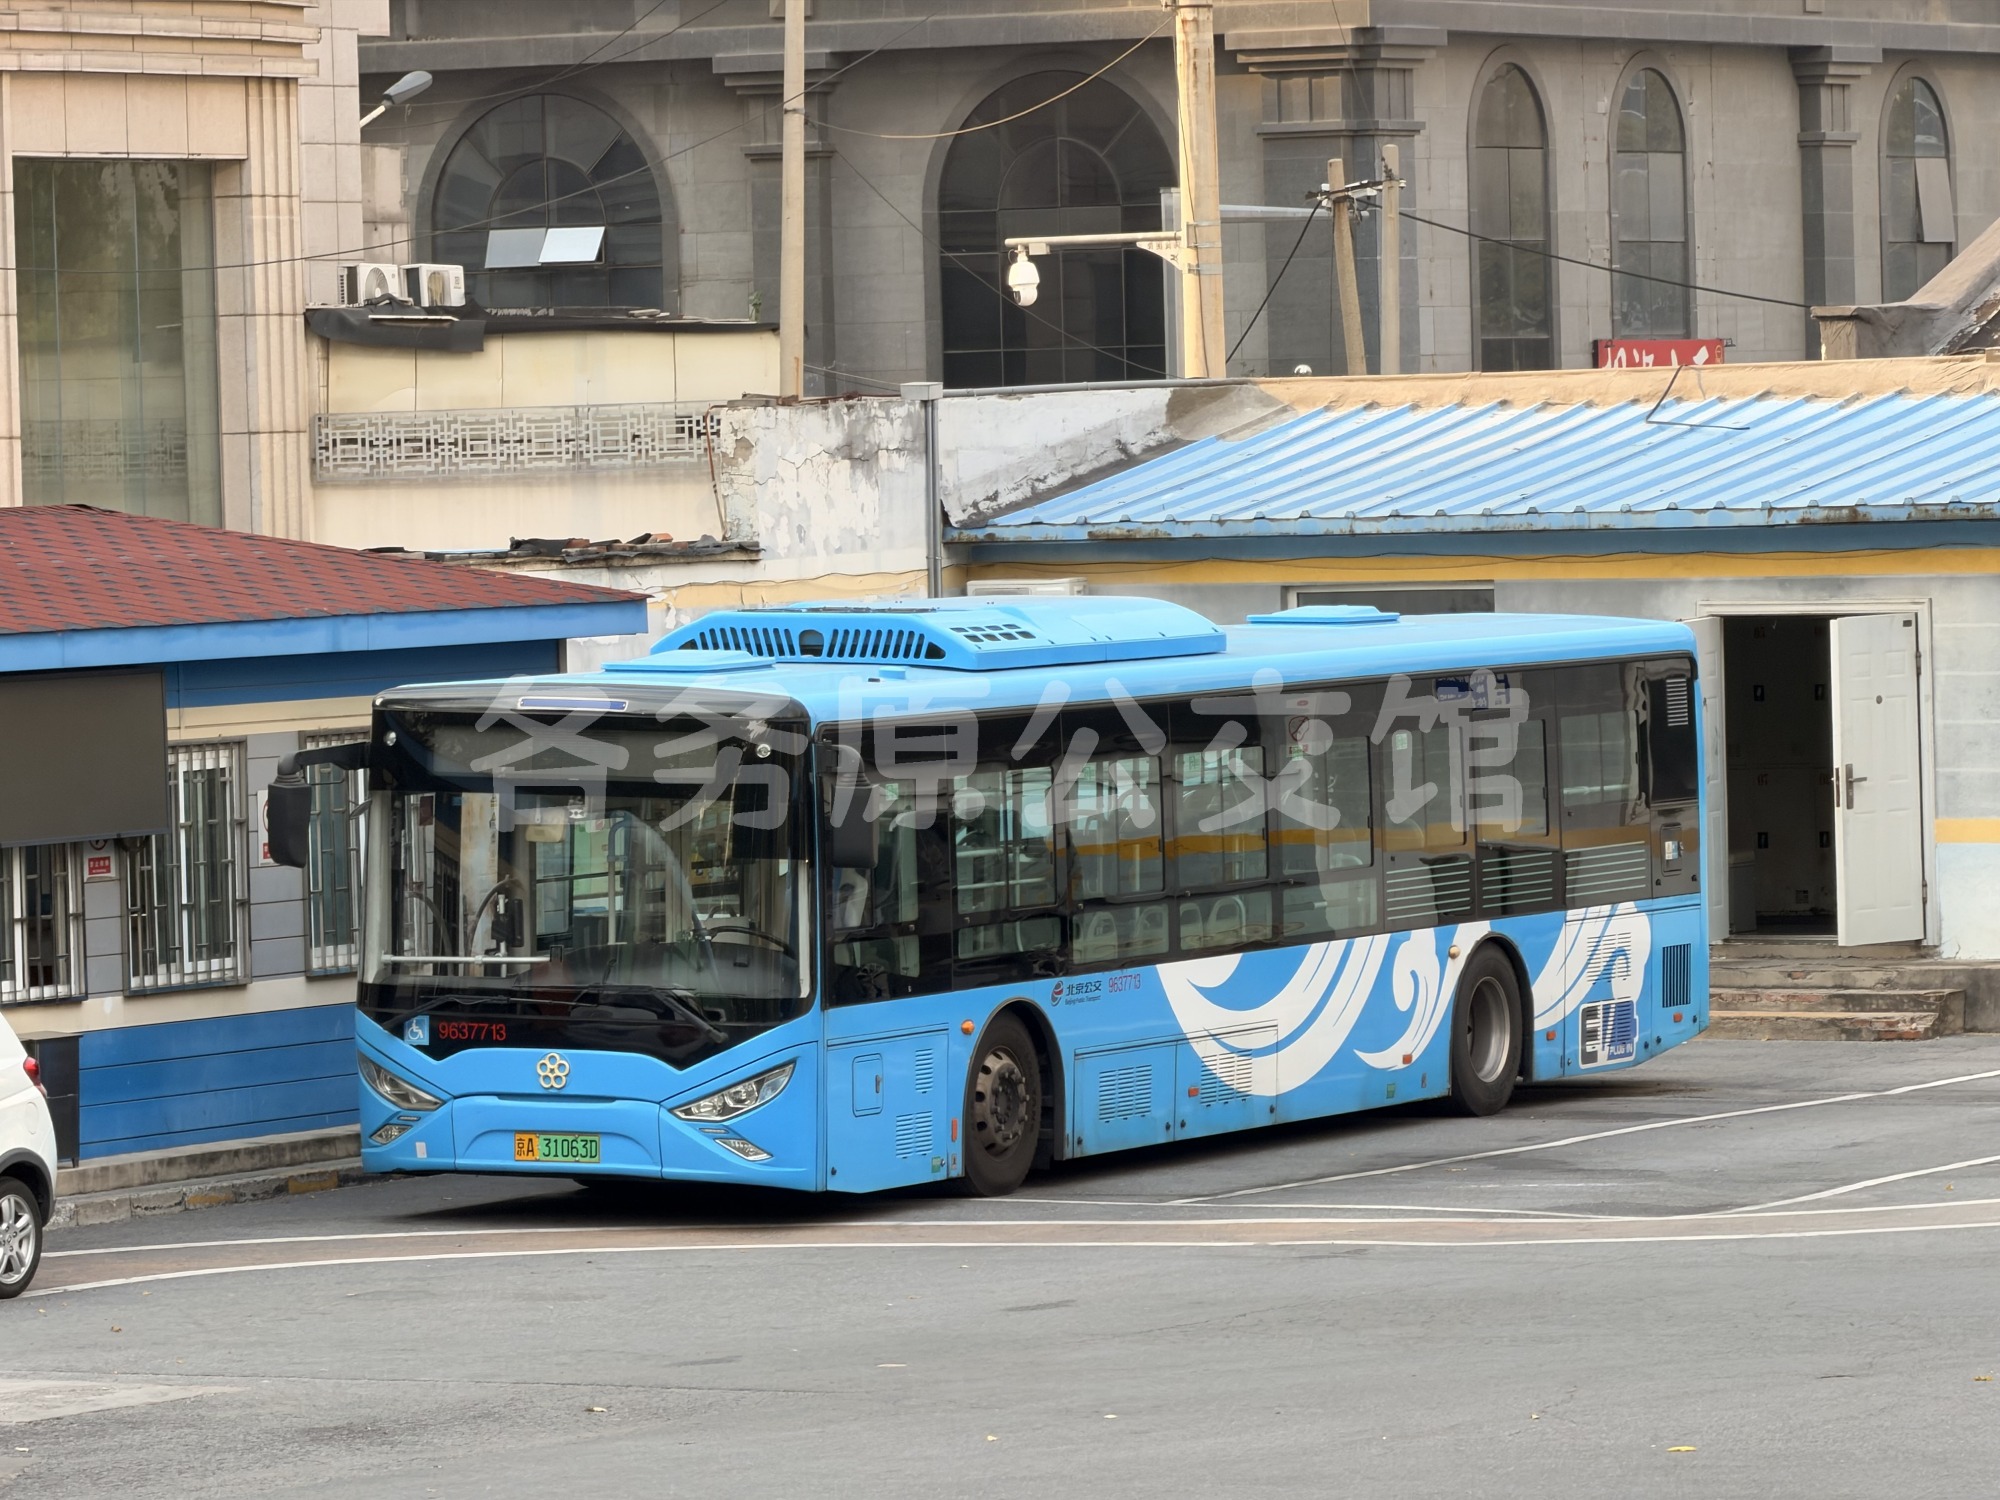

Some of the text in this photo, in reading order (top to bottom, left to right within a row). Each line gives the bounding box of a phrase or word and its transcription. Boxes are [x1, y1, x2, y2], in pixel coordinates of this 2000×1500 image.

[1066, 981, 1102, 996] 北京公交
[1109, 974, 1141, 993] 9637713
[438, 1022, 506, 1041] 9637713
[1610, 1043, 1633, 1055] PLUG IN
